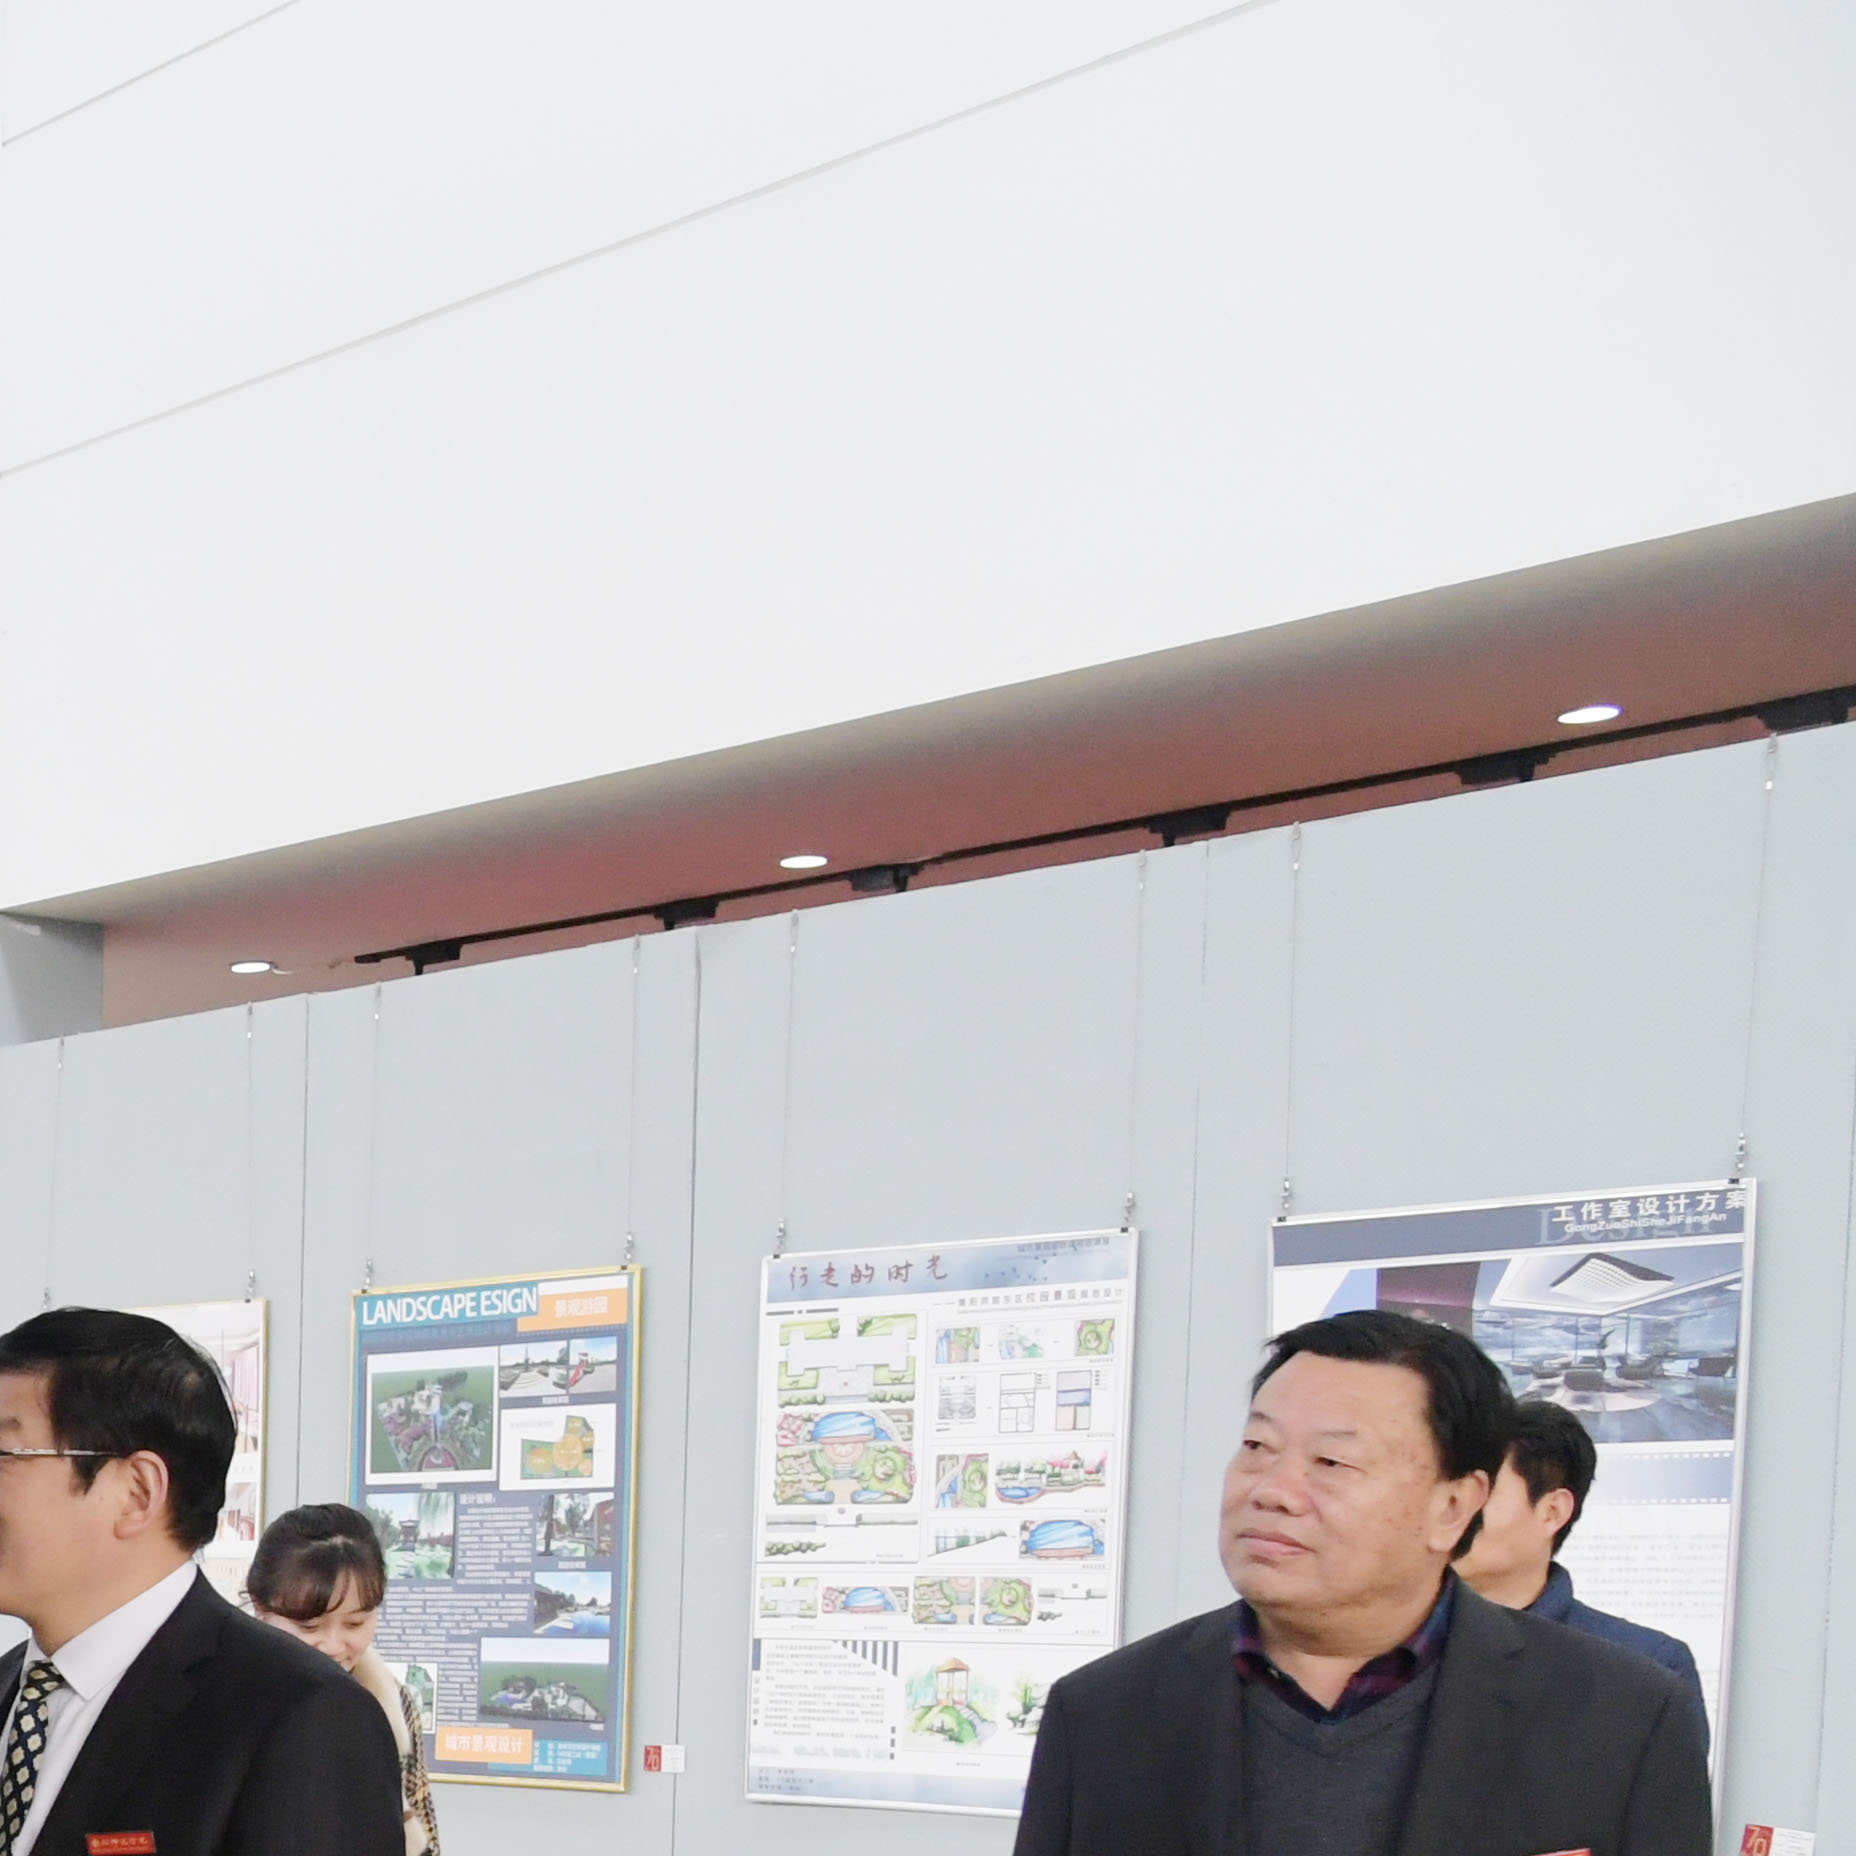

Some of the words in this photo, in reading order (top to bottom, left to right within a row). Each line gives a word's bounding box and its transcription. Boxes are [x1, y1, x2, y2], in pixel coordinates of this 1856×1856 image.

[1552, 1190, 1747, 1222] 工作室设计方案
[789, 1253, 948, 1291] 行走的时光
[362, 1291, 477, 1326] LANDSCAPE
[480, 1286, 537, 1315] ESIGN
[445, 1734, 524, 1753] 城市景观设计
